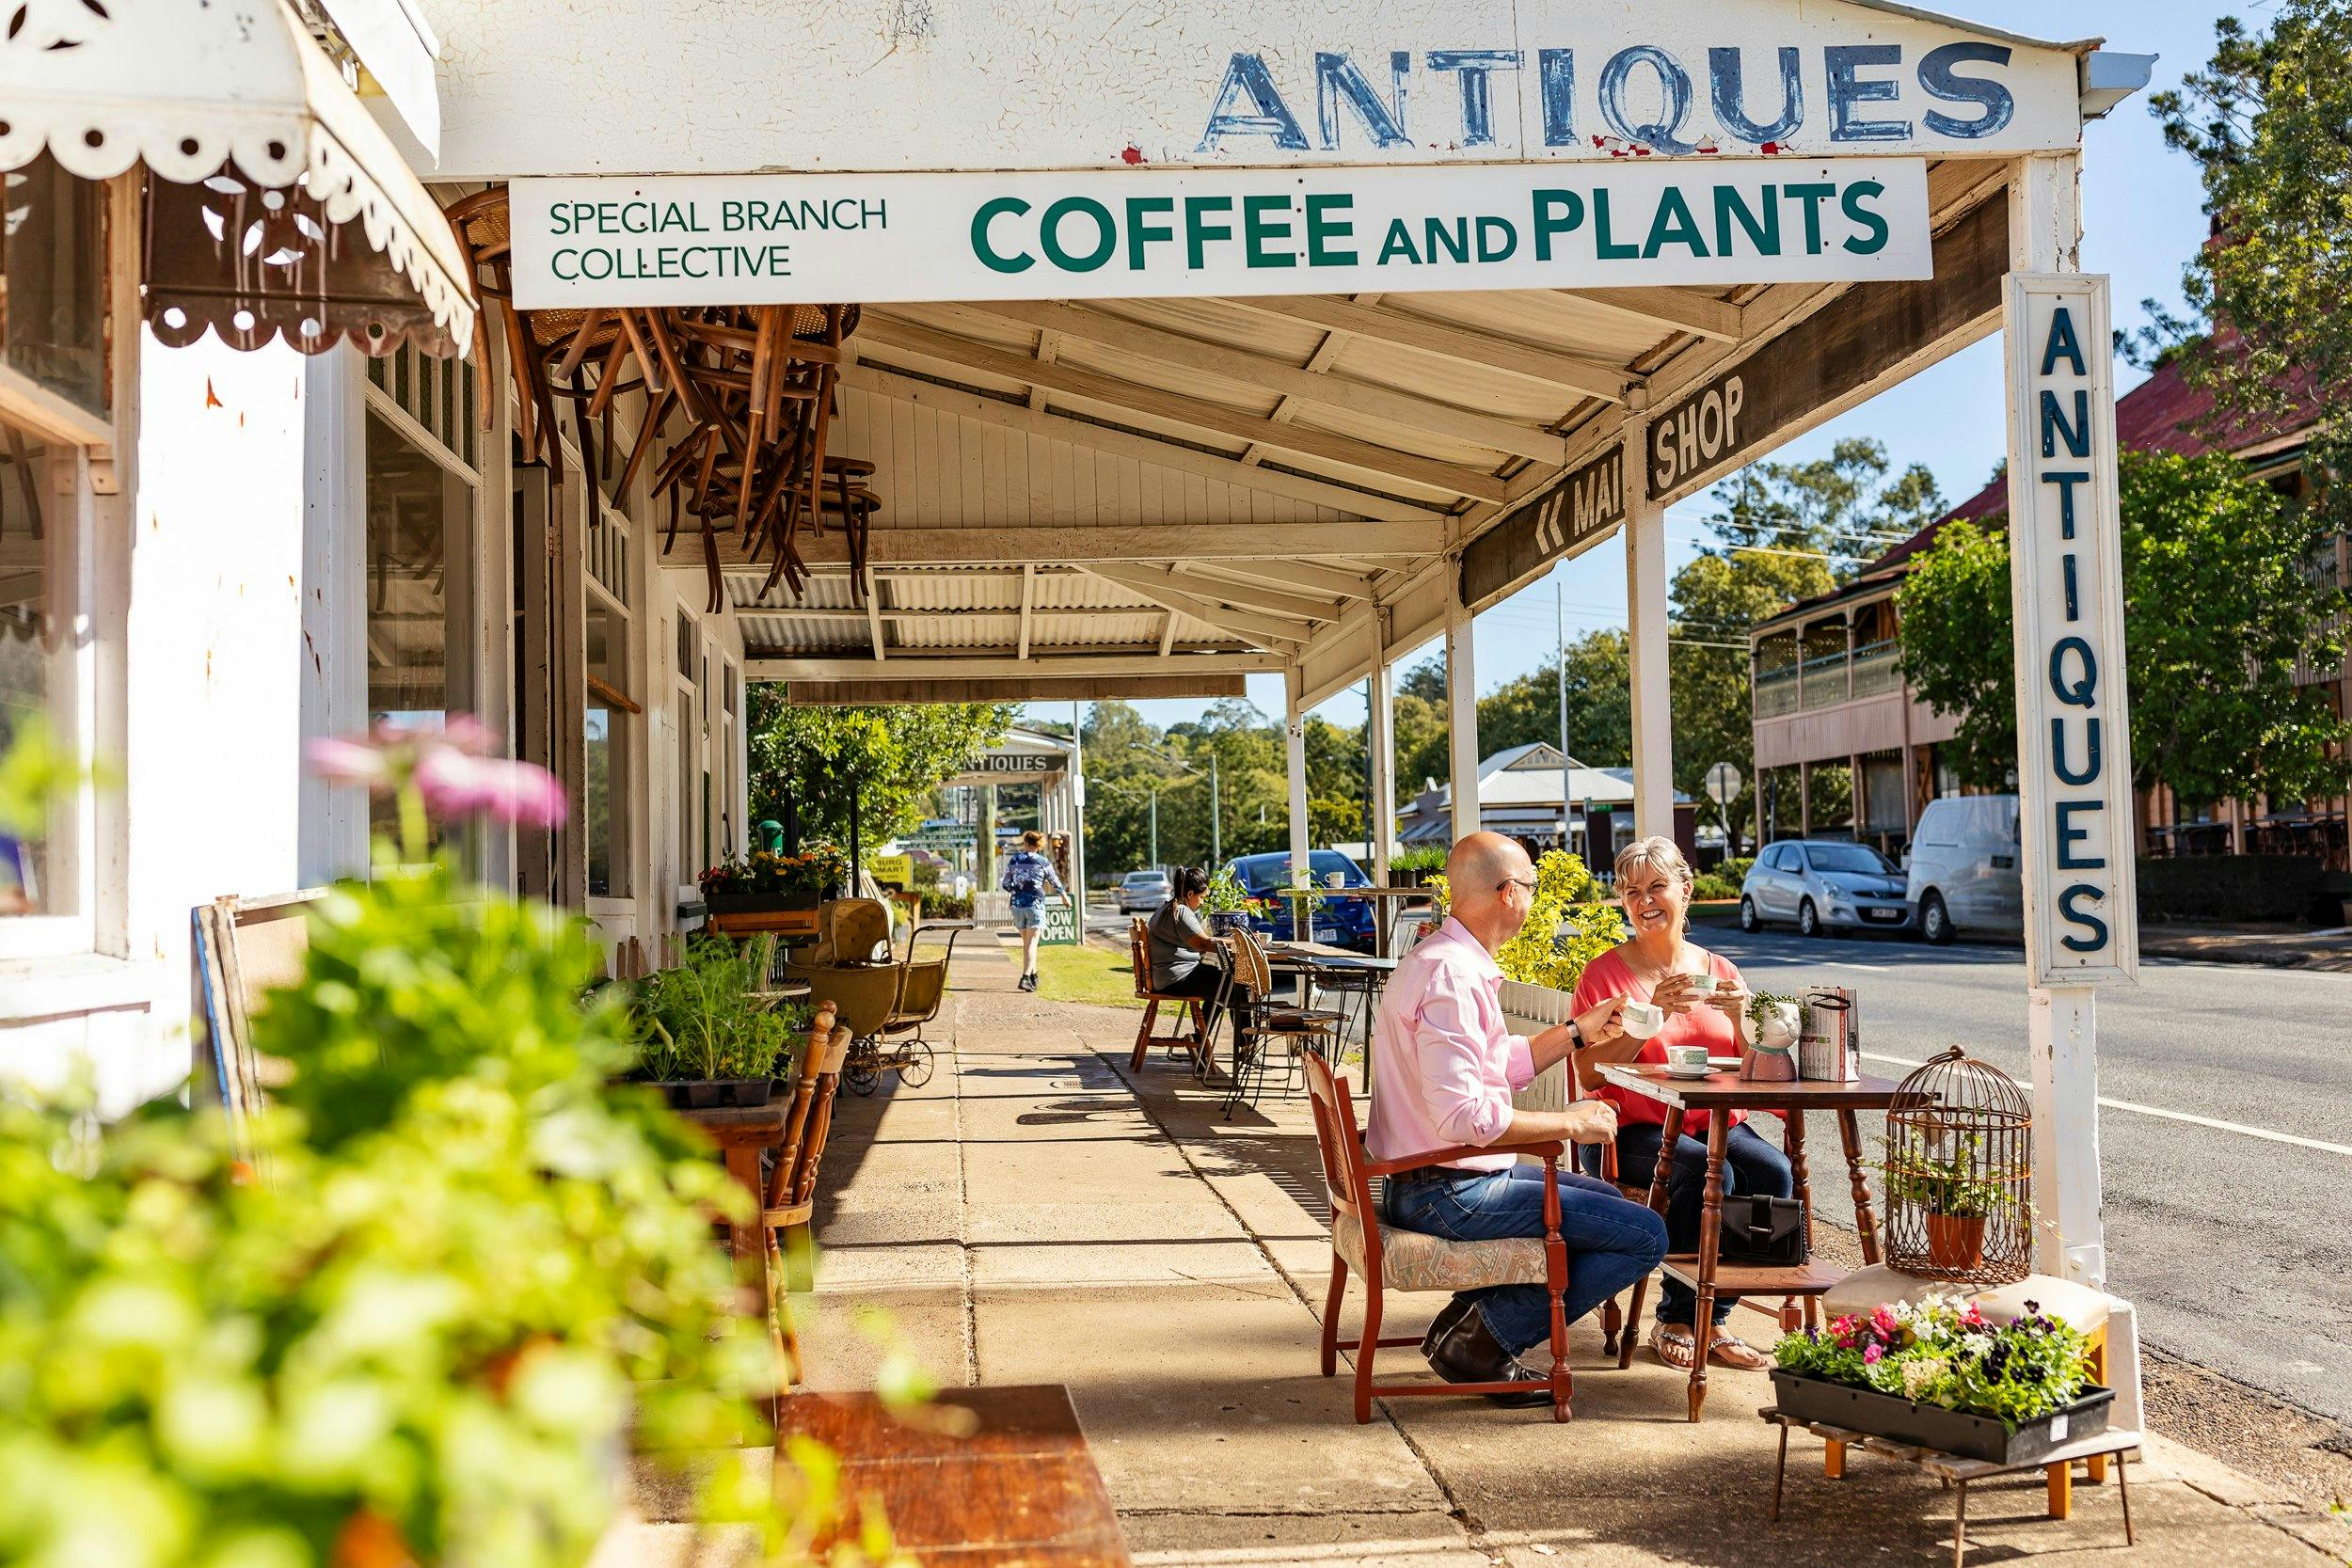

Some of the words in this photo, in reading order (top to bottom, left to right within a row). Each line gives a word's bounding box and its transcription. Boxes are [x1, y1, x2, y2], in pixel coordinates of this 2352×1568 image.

[1195, 41, 2014, 156] ANTIQUES
[549, 201, 708, 235] SPECIAL
[723, 198, 886, 231] BRANCH
[970, 193, 1359, 274] COFFEE
[1376, 215, 1518, 265] AND
[1533, 180, 1889, 261] PLANTS
[551, 245, 791, 280] COLLECTIVE
[1574, 455, 1626, 537] MAI
[1656, 375, 1743, 489] SHOP
[2040, 308, 2108, 952] ANTIQUES
[962, 756, 1047, 771] NTIQUES
[1040, 926, 1075, 941] OPEN
